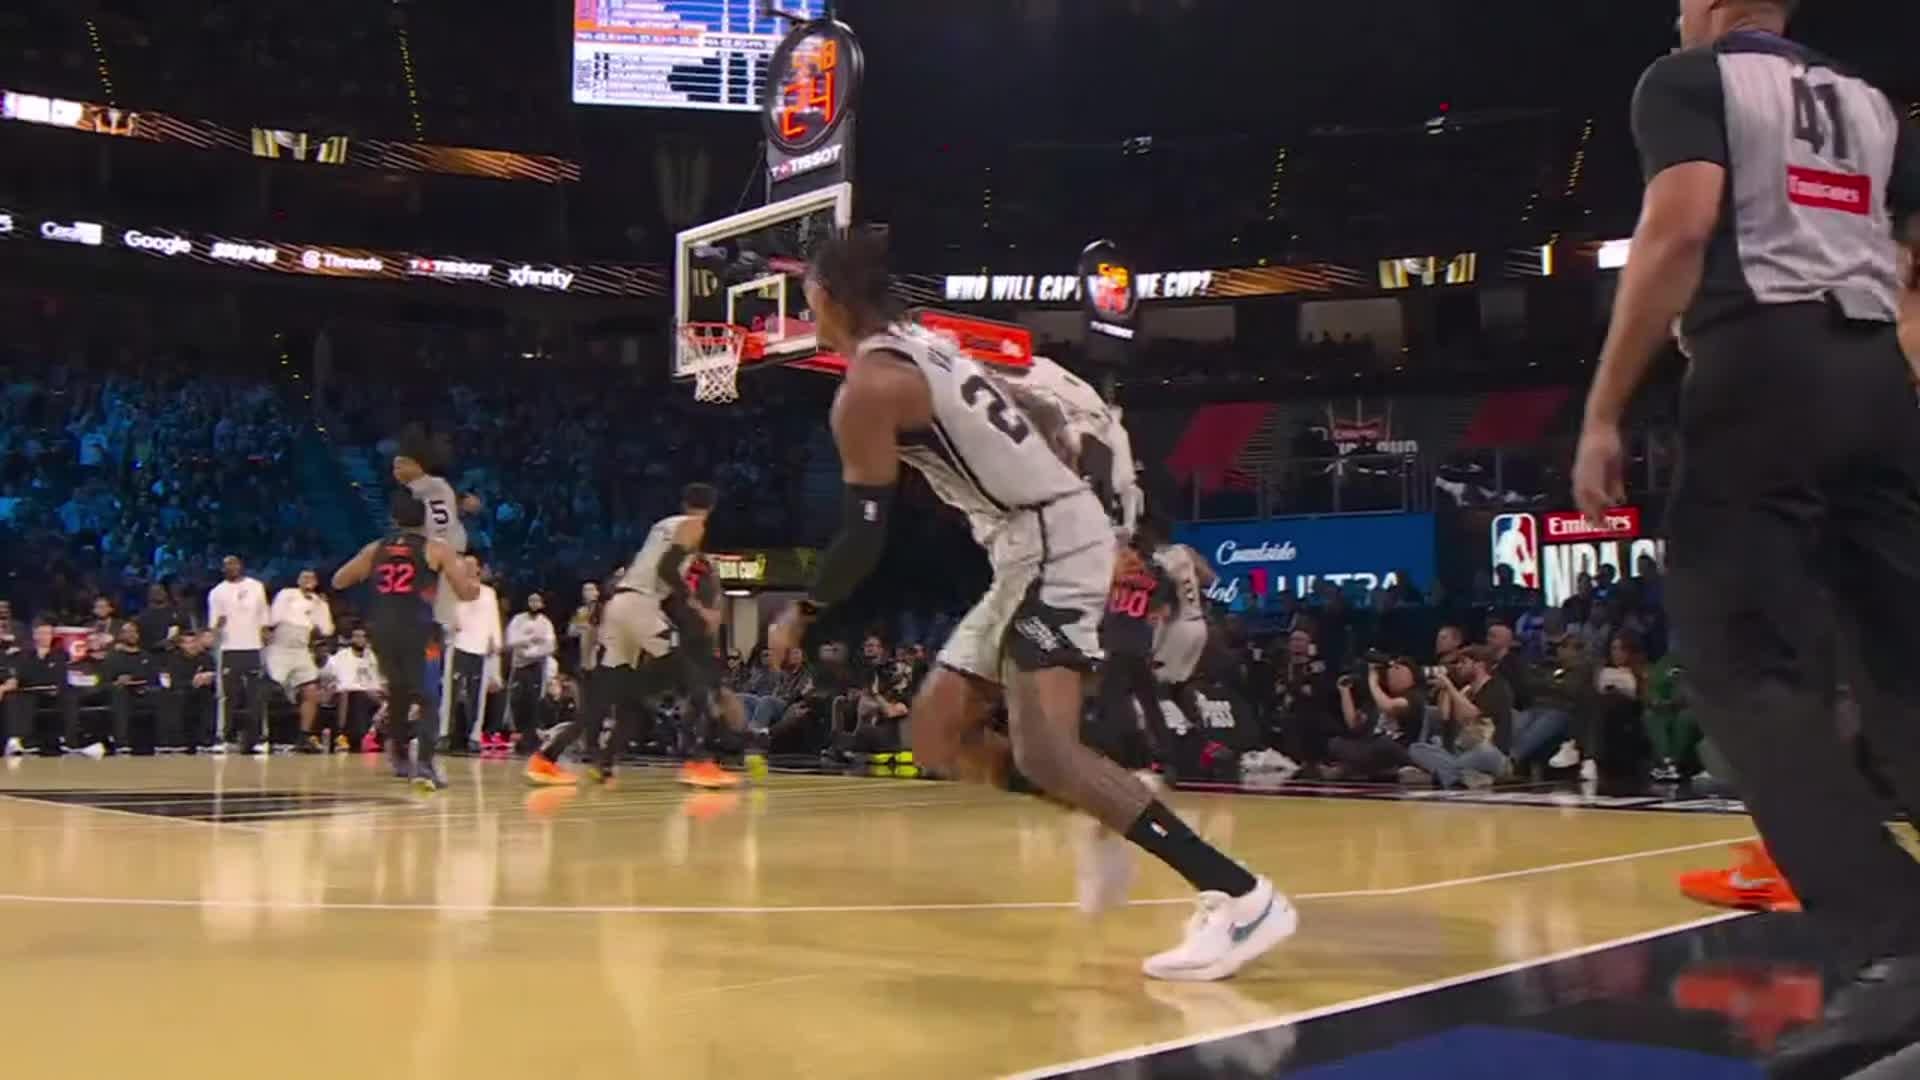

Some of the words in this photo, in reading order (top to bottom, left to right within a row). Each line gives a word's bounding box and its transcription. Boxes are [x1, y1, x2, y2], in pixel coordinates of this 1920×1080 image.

[1791, 76, 1849, 160] 41
[790, 144, 842, 173] TISSOT
[124, 230, 191, 255] Google
[324, 253, 383, 272] Threads
[436, 259, 492, 276] TISSOT
[508, 264, 574, 291] xfinity
[945, 274, 989, 301] WHO
[991, 274, 1034, 301] WILL
[960, 374, 1030, 446] 2
[430, 499, 449, 525] 5
[1547, 513, 1632, 536] Emites
[376, 562, 415, 593] 32
